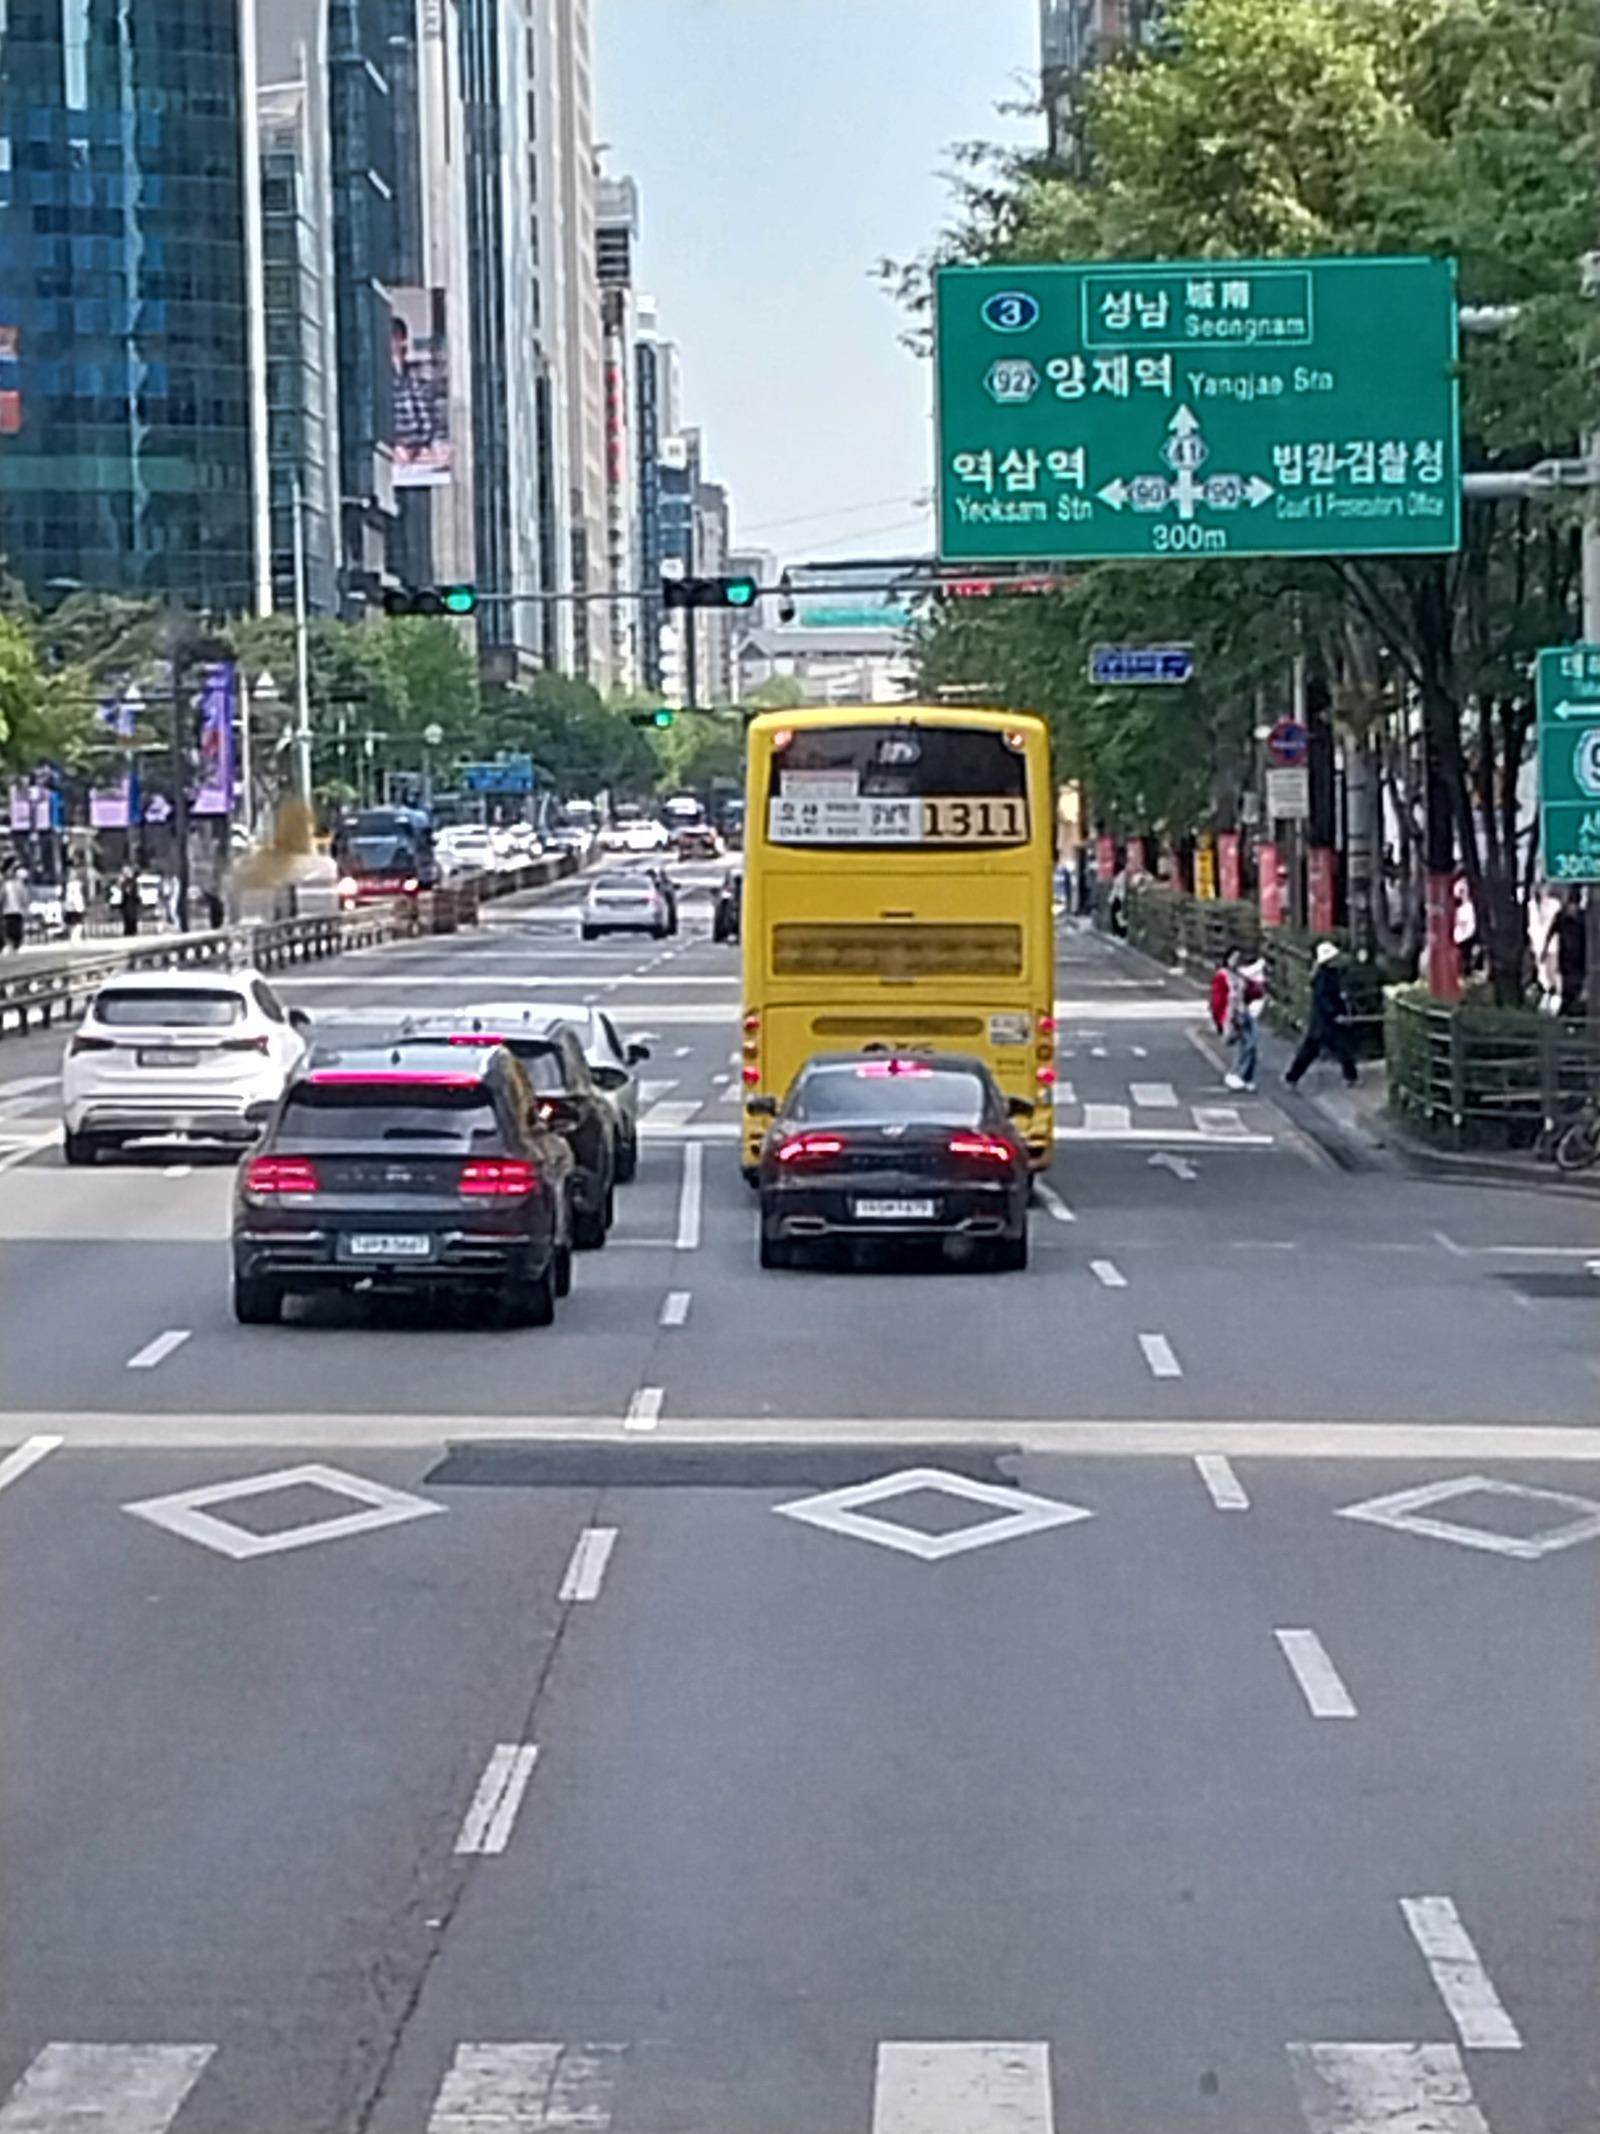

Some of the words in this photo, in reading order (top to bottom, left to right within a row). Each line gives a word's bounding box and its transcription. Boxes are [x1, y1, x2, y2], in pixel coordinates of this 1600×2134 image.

[999, 299, 1022, 326] 3
[1098, 290, 1169, 329] 성남
[1184, 313, 1305, 343] Seongnam
[1046, 353, 1172, 399] 양재역
[1186, 370, 1284, 401] Yangjae
[1293, 366, 1334, 393] Stn
[953, 446, 1085, 494] 역삼역
[955, 494, 1047, 523] Yeoksam
[1057, 493, 1093, 521] Stn
[1153, 523, 1227, 550] 300m
[924, 803, 1021, 836] 1311
